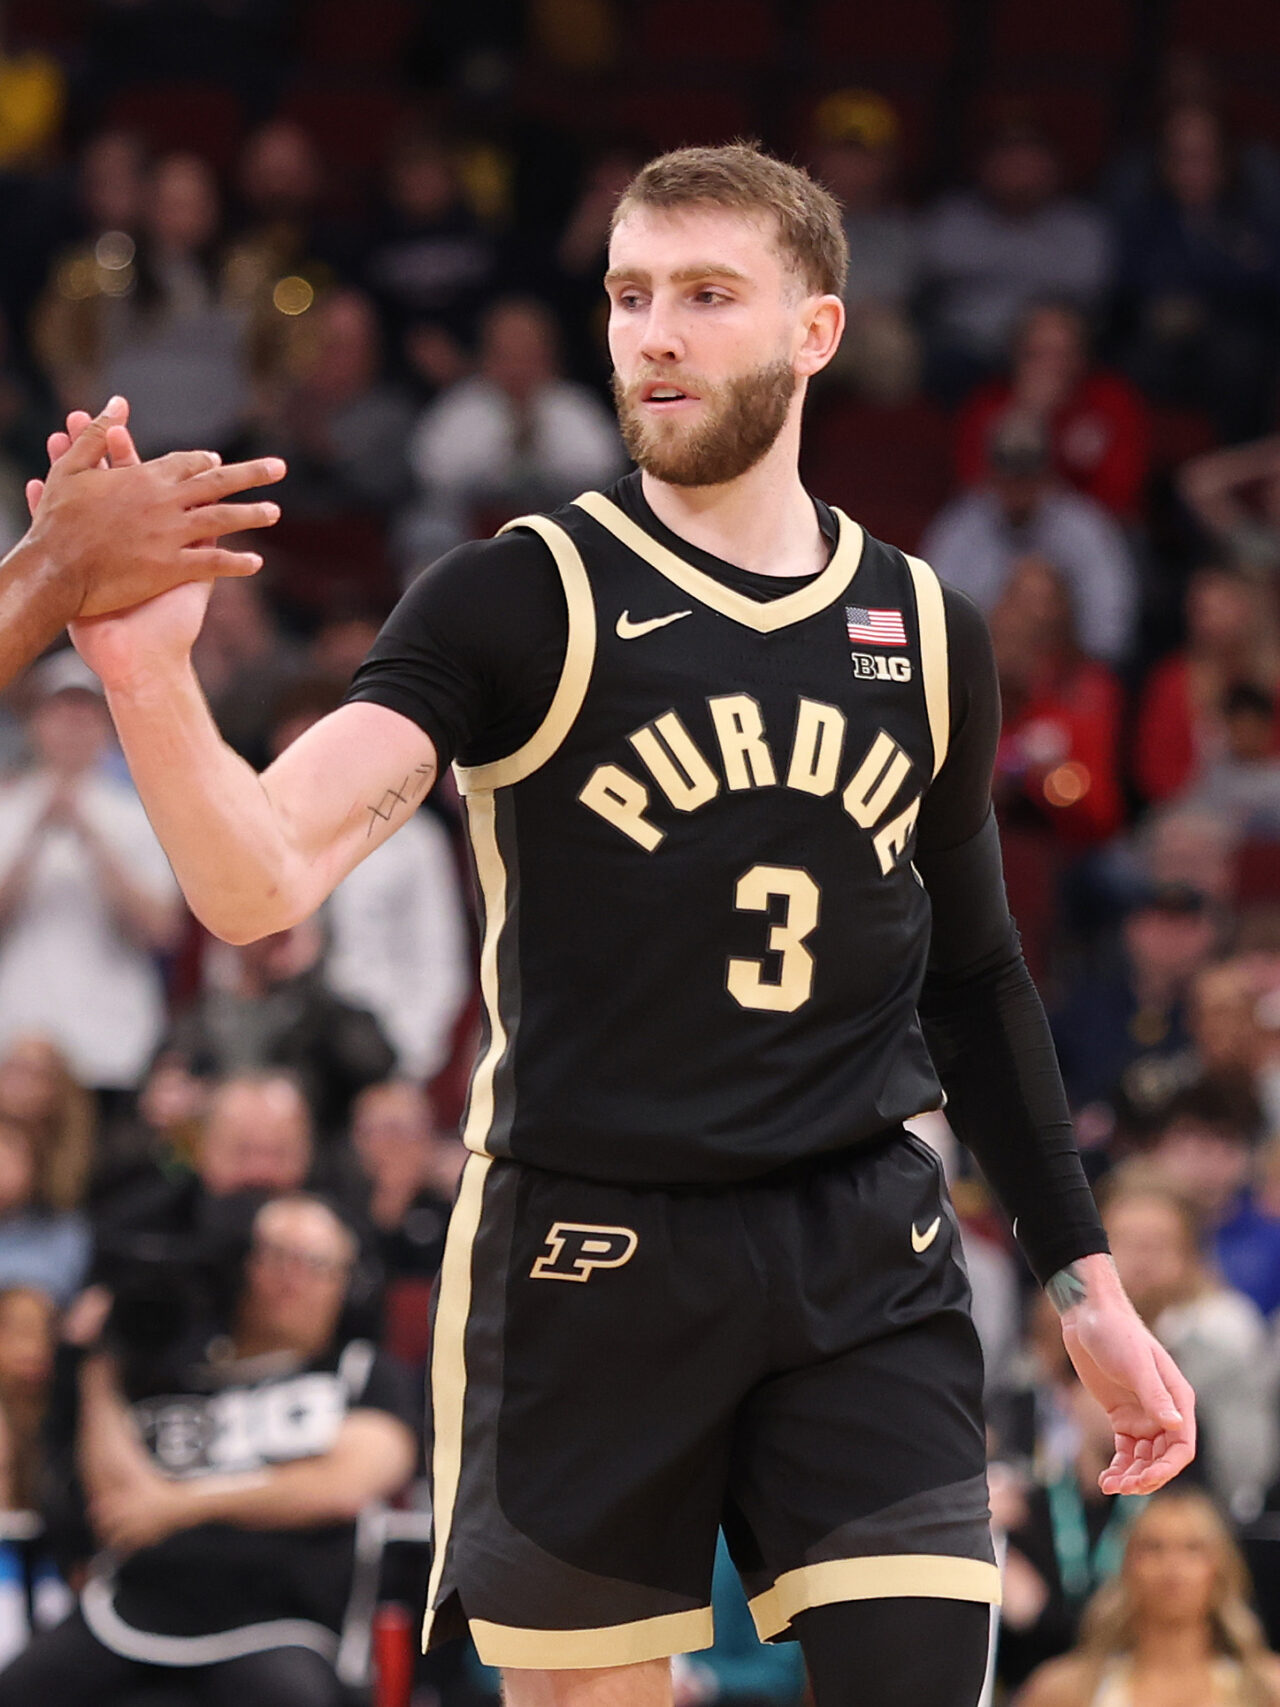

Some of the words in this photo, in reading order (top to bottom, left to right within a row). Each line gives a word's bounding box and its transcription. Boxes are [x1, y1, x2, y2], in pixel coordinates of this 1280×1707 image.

[577, 691, 921, 880] PURDUE
[724, 862, 821, 1014] 3
[529, 1222, 639, 1283] P
